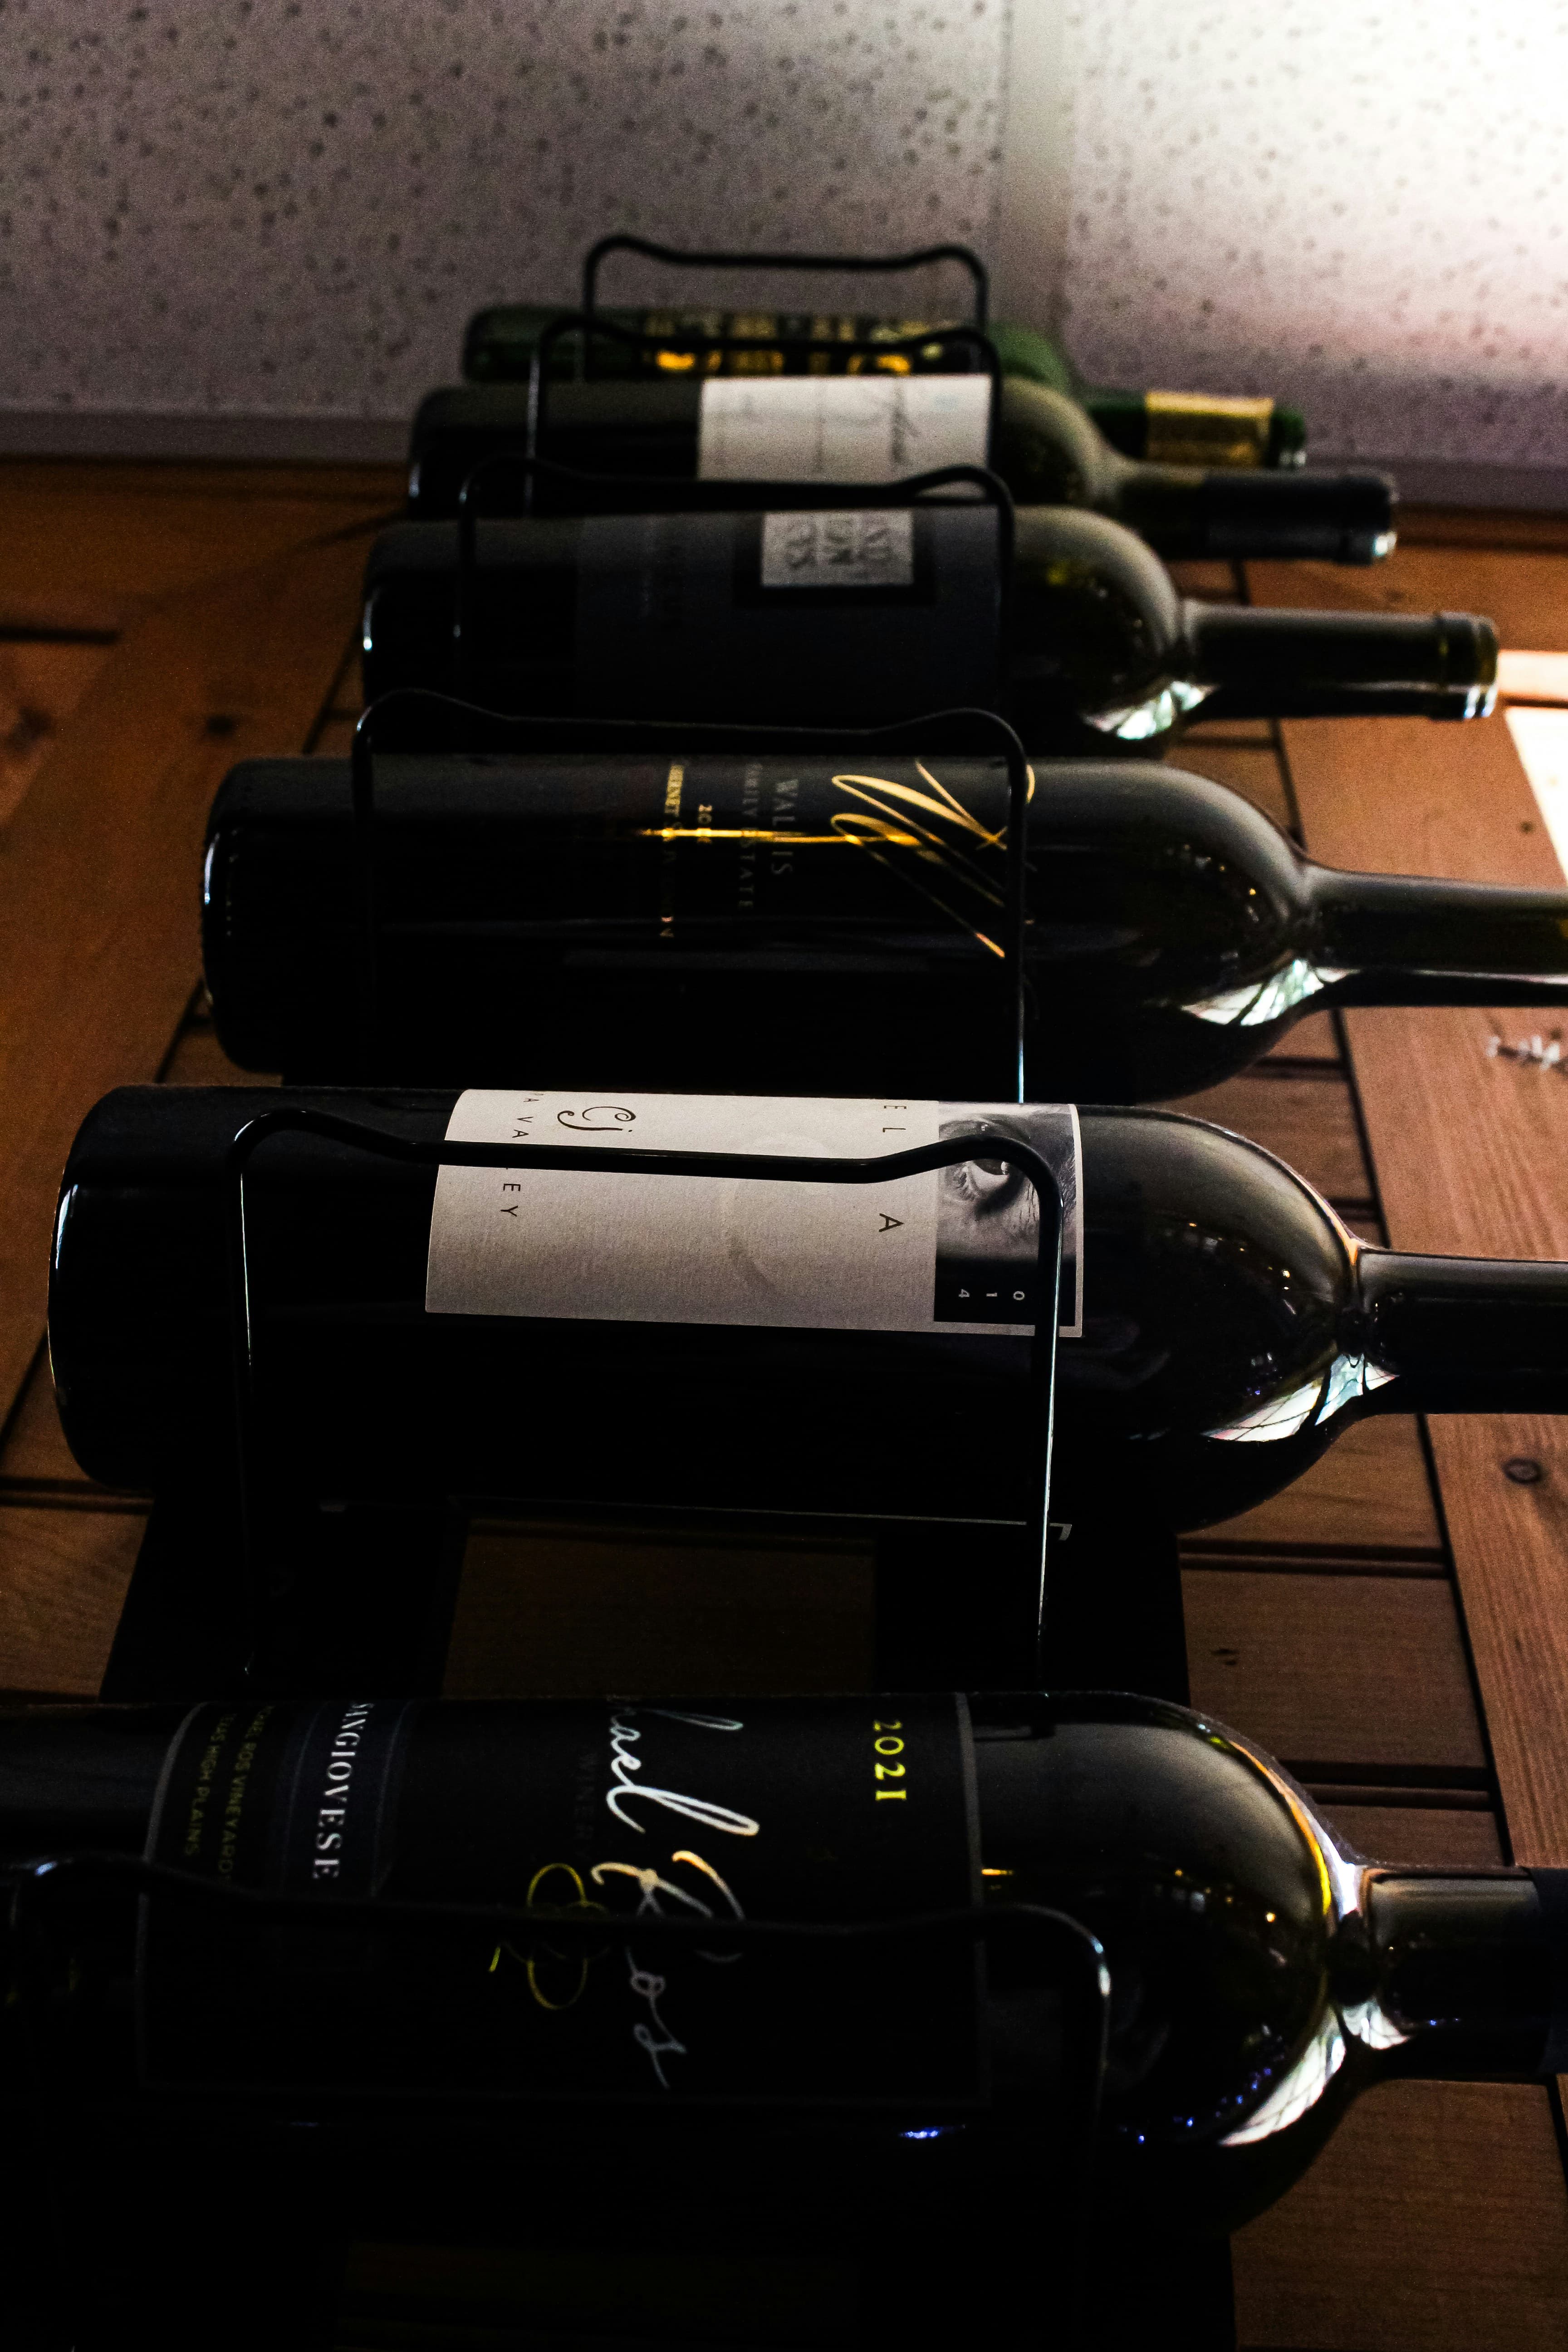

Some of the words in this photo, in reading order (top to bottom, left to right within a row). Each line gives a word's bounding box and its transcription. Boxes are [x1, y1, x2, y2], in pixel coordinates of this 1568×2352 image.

[501, 1116, 534, 1217] VAEY
[959, 1288, 1025, 1301] 014
[197, 1744, 222, 1781] HIGH
[311, 1701, 374, 1880] SANGIOVESE
[873, 1719, 907, 1803] 2021
[183, 1786, 211, 1857] PLAINS
